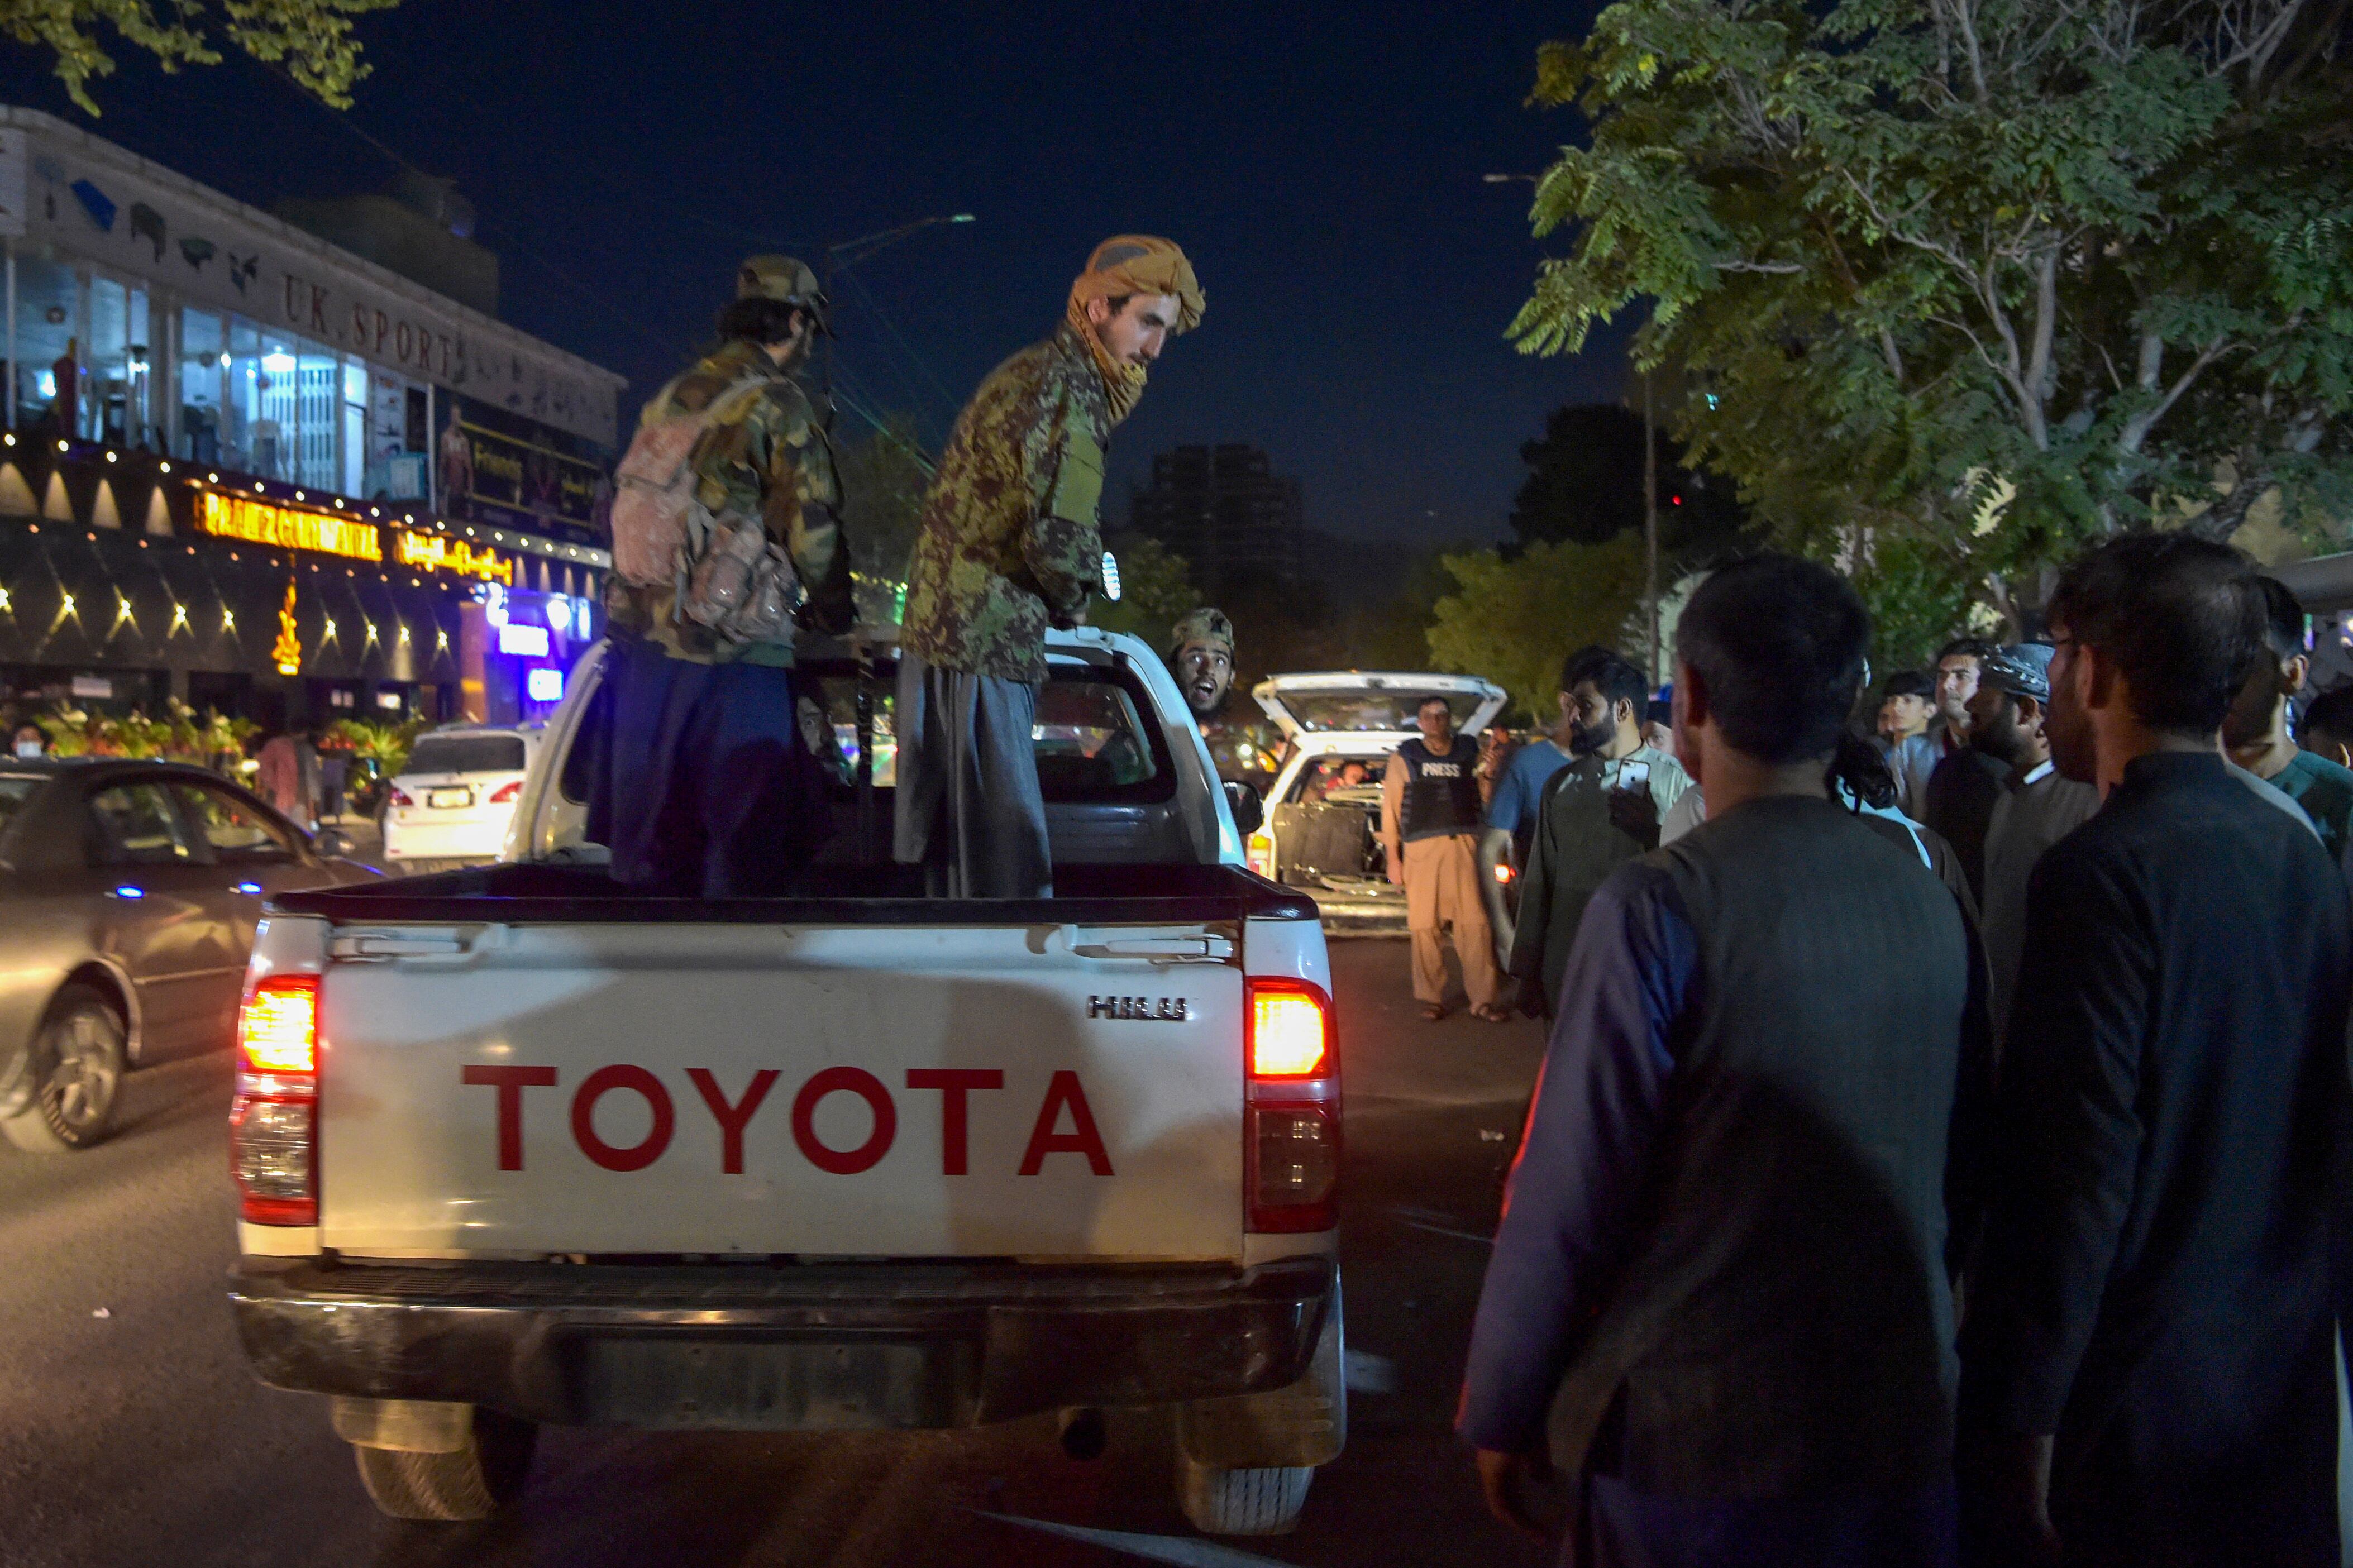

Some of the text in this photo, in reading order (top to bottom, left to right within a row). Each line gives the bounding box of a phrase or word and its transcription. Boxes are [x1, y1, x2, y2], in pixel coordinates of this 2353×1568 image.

[284, 274, 450, 376] UK SPORT
[1421, 762, 1461, 777] PRESS
[460, 1064, 1115, 1176] TOYOTA
